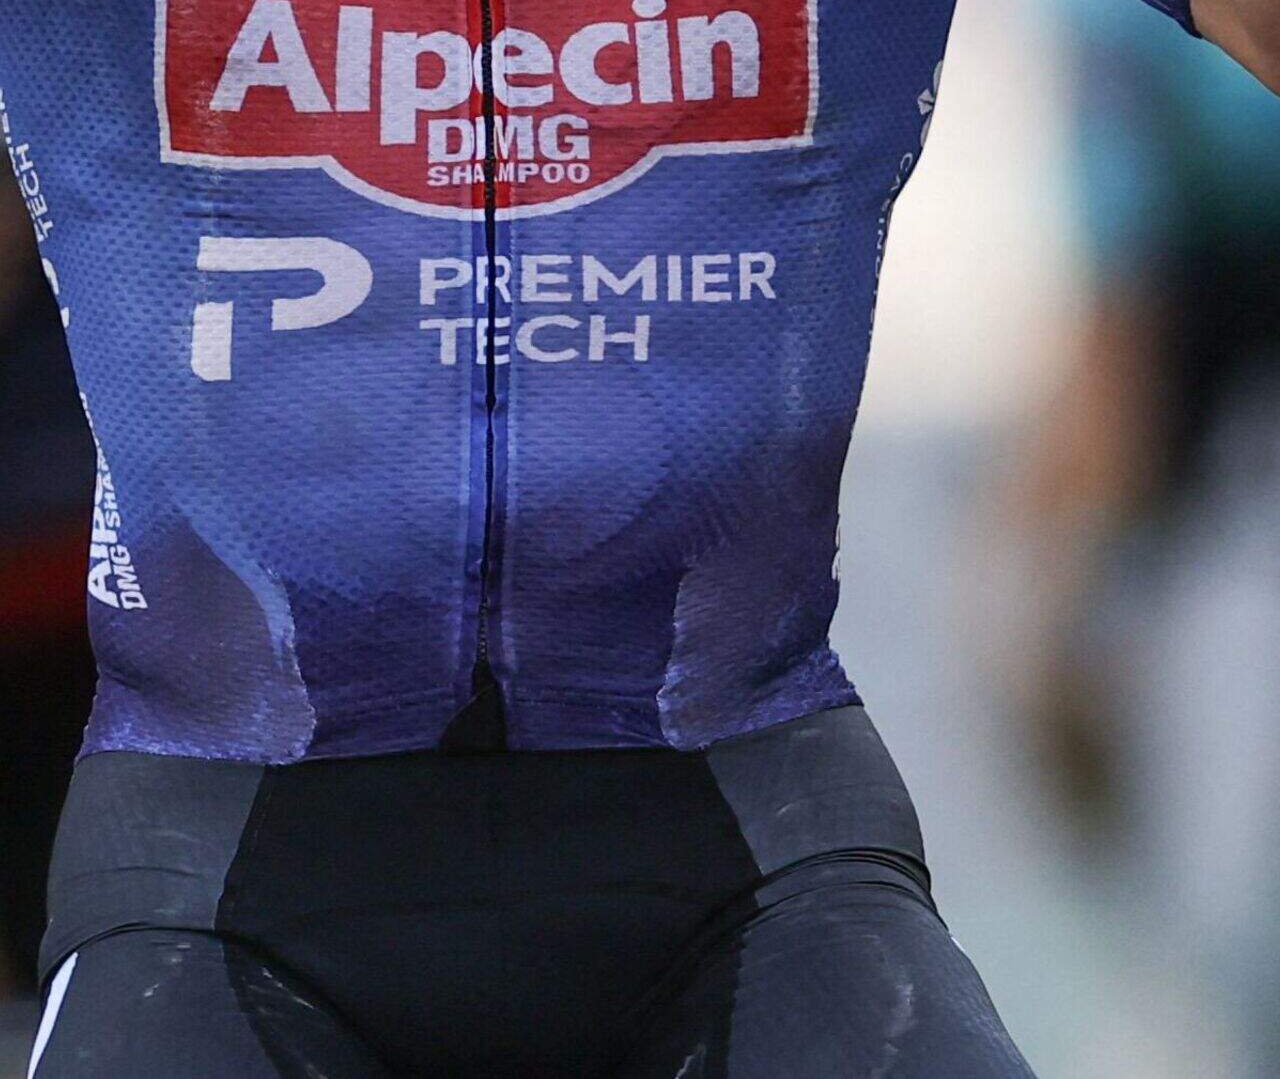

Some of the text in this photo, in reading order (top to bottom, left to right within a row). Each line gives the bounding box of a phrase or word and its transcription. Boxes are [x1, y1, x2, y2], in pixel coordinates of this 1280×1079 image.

[428, 113, 591, 163] DMG
[16, 142, 54, 239] TECH
[426, 162, 591, 187] SHAMPOO
[420, 251, 776, 306] PREMIER
[420, 315, 651, 365] TECH
[110, 543, 149, 611] DMG
